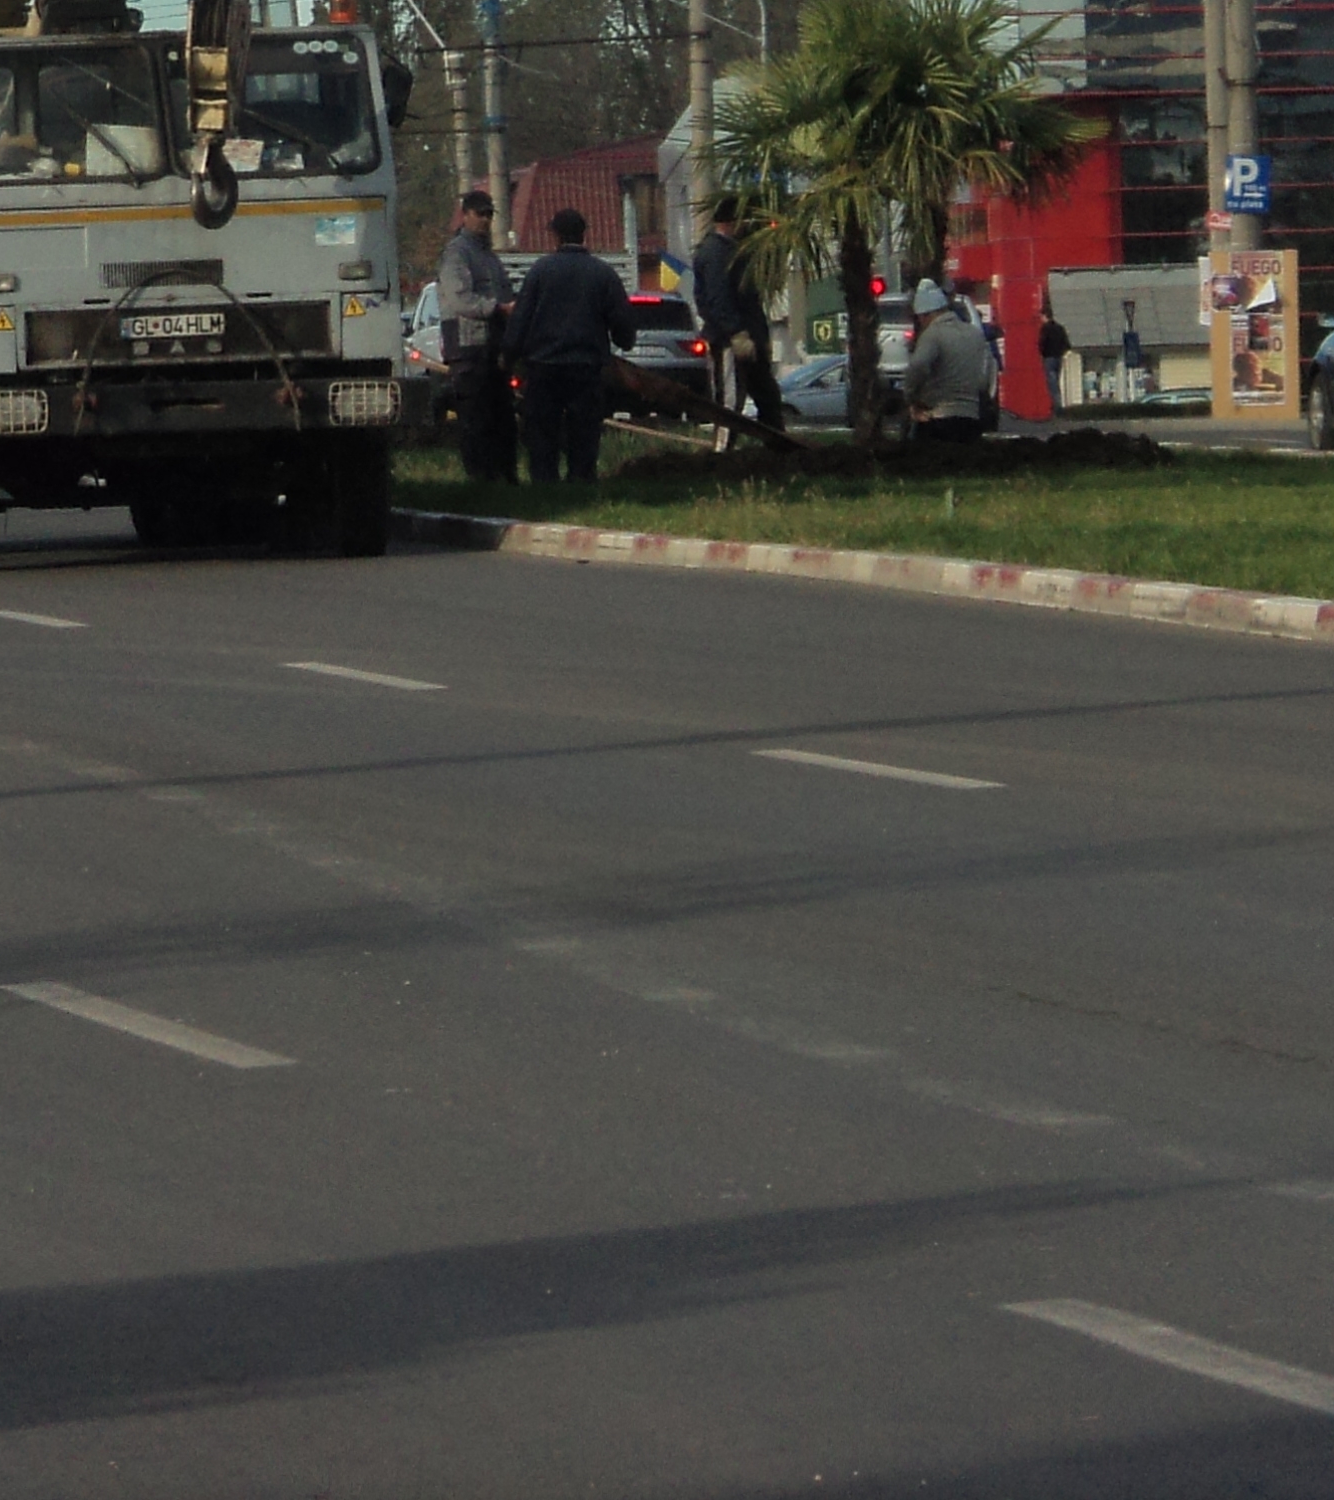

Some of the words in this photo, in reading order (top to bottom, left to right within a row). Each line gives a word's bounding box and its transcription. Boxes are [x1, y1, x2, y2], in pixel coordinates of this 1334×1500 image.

[1232, 157, 1259, 197] P
[1231, 259, 1282, 276] FUEGO
[132, 318, 155, 336] GL
[162, 317, 183, 334] 04
[186, 315, 222, 333] HLM
